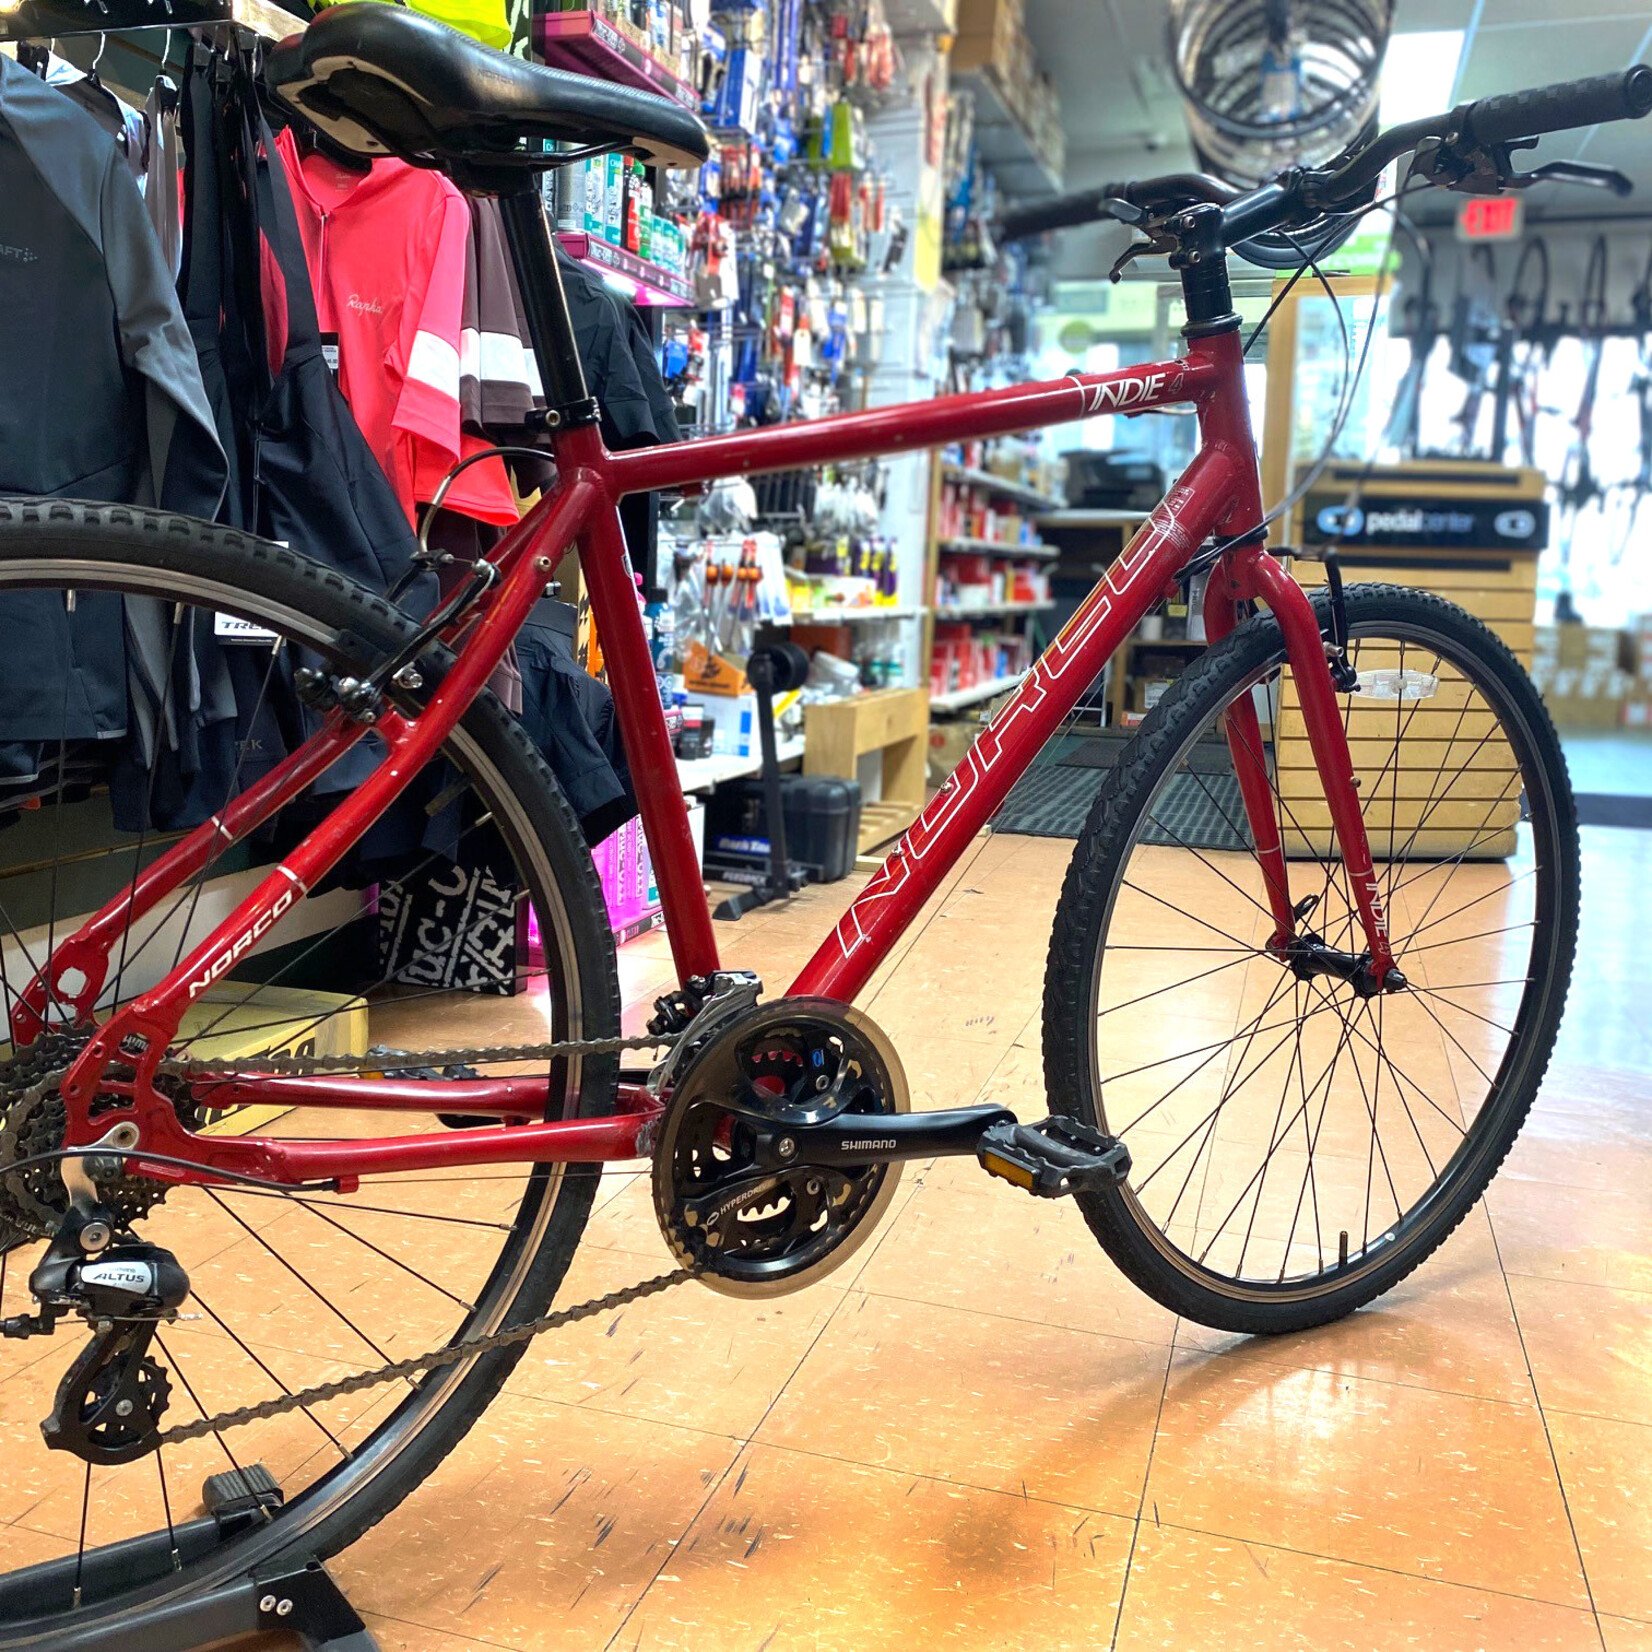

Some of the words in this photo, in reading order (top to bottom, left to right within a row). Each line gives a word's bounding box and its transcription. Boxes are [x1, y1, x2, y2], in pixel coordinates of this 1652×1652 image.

[346, 293, 383, 317] Rapha
[1088, 372, 1166, 411] INDIE
[221, 621, 262, 630] TRE
[1365, 882, 1388, 938] INDIE
[188, 889, 293, 999] NORCO
[841, 1139, 897, 1150] SHIMANO
[93, 1272, 145, 1283] ALTUS
